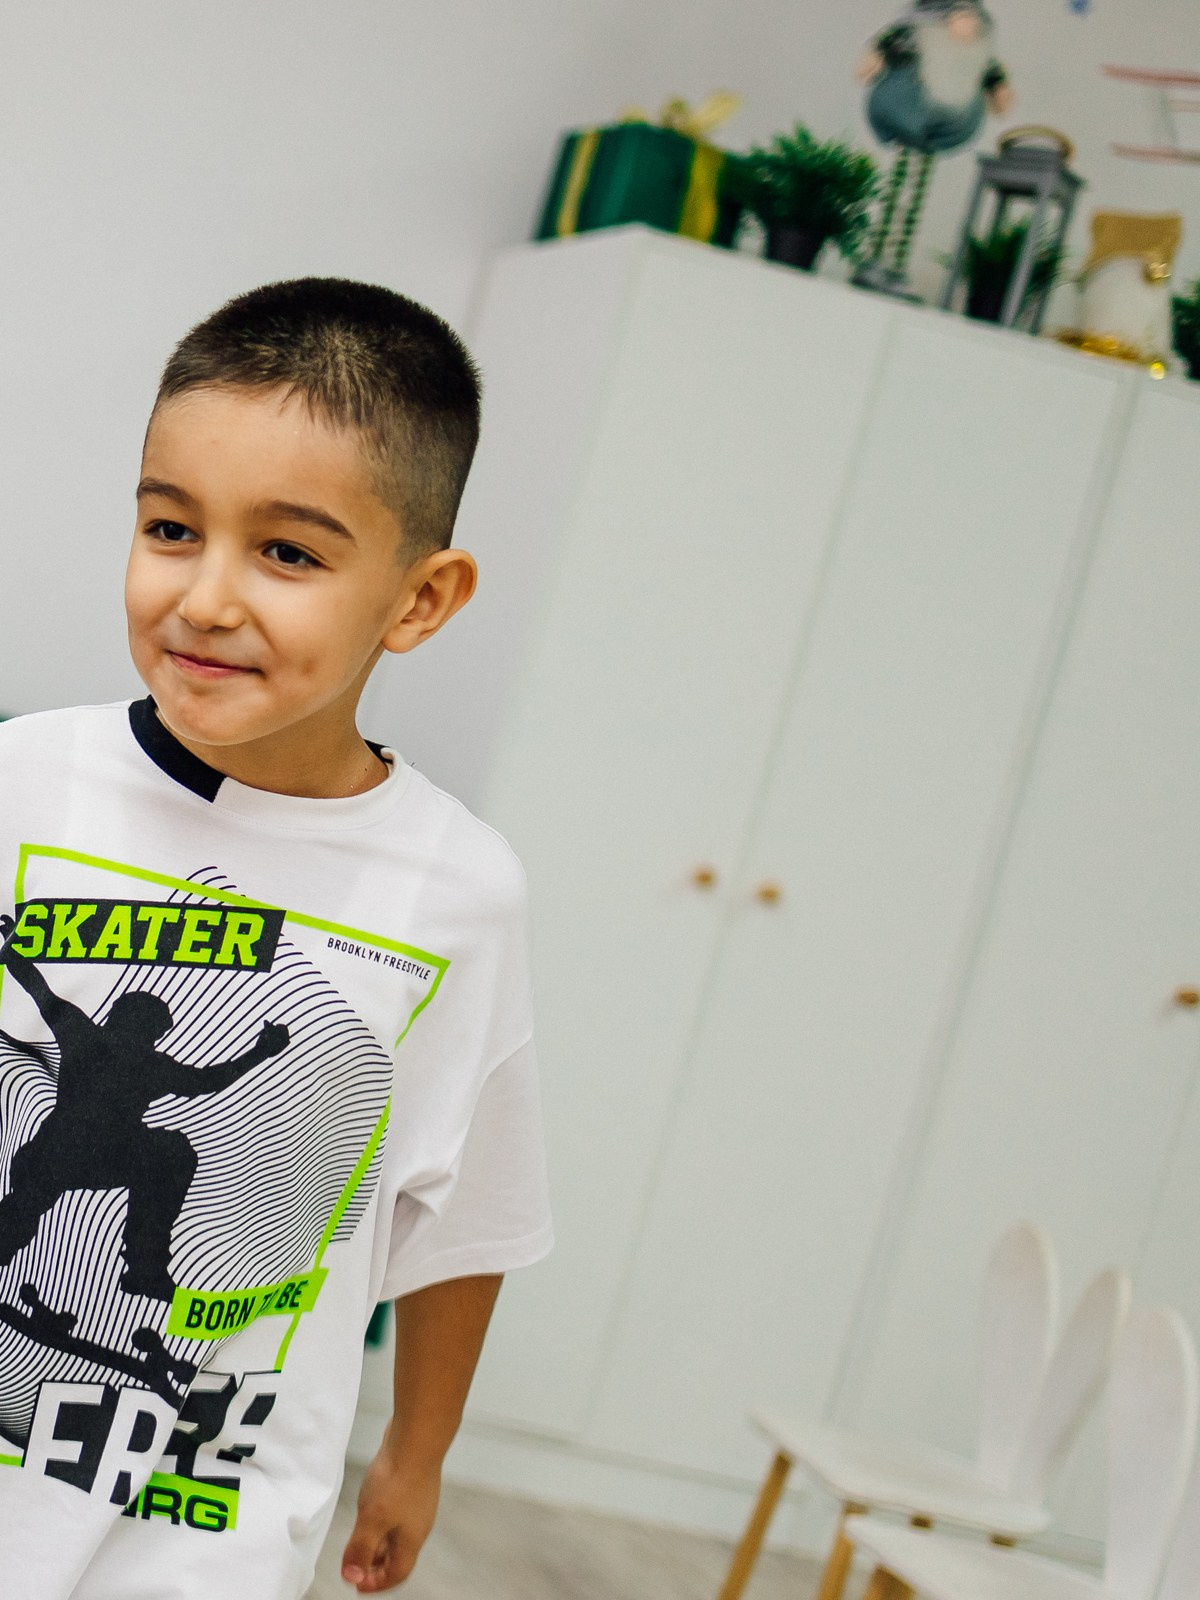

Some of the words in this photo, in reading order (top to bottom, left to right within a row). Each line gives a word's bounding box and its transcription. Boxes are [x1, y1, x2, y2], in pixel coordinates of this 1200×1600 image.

[11, 904, 266, 967] SKATER
[327, 937, 382, 963] BROOKLYN
[383, 955, 432, 980] FREESTYLE
[185, 1296, 257, 1331] BORN
[274, 1280, 309, 1310] BE
